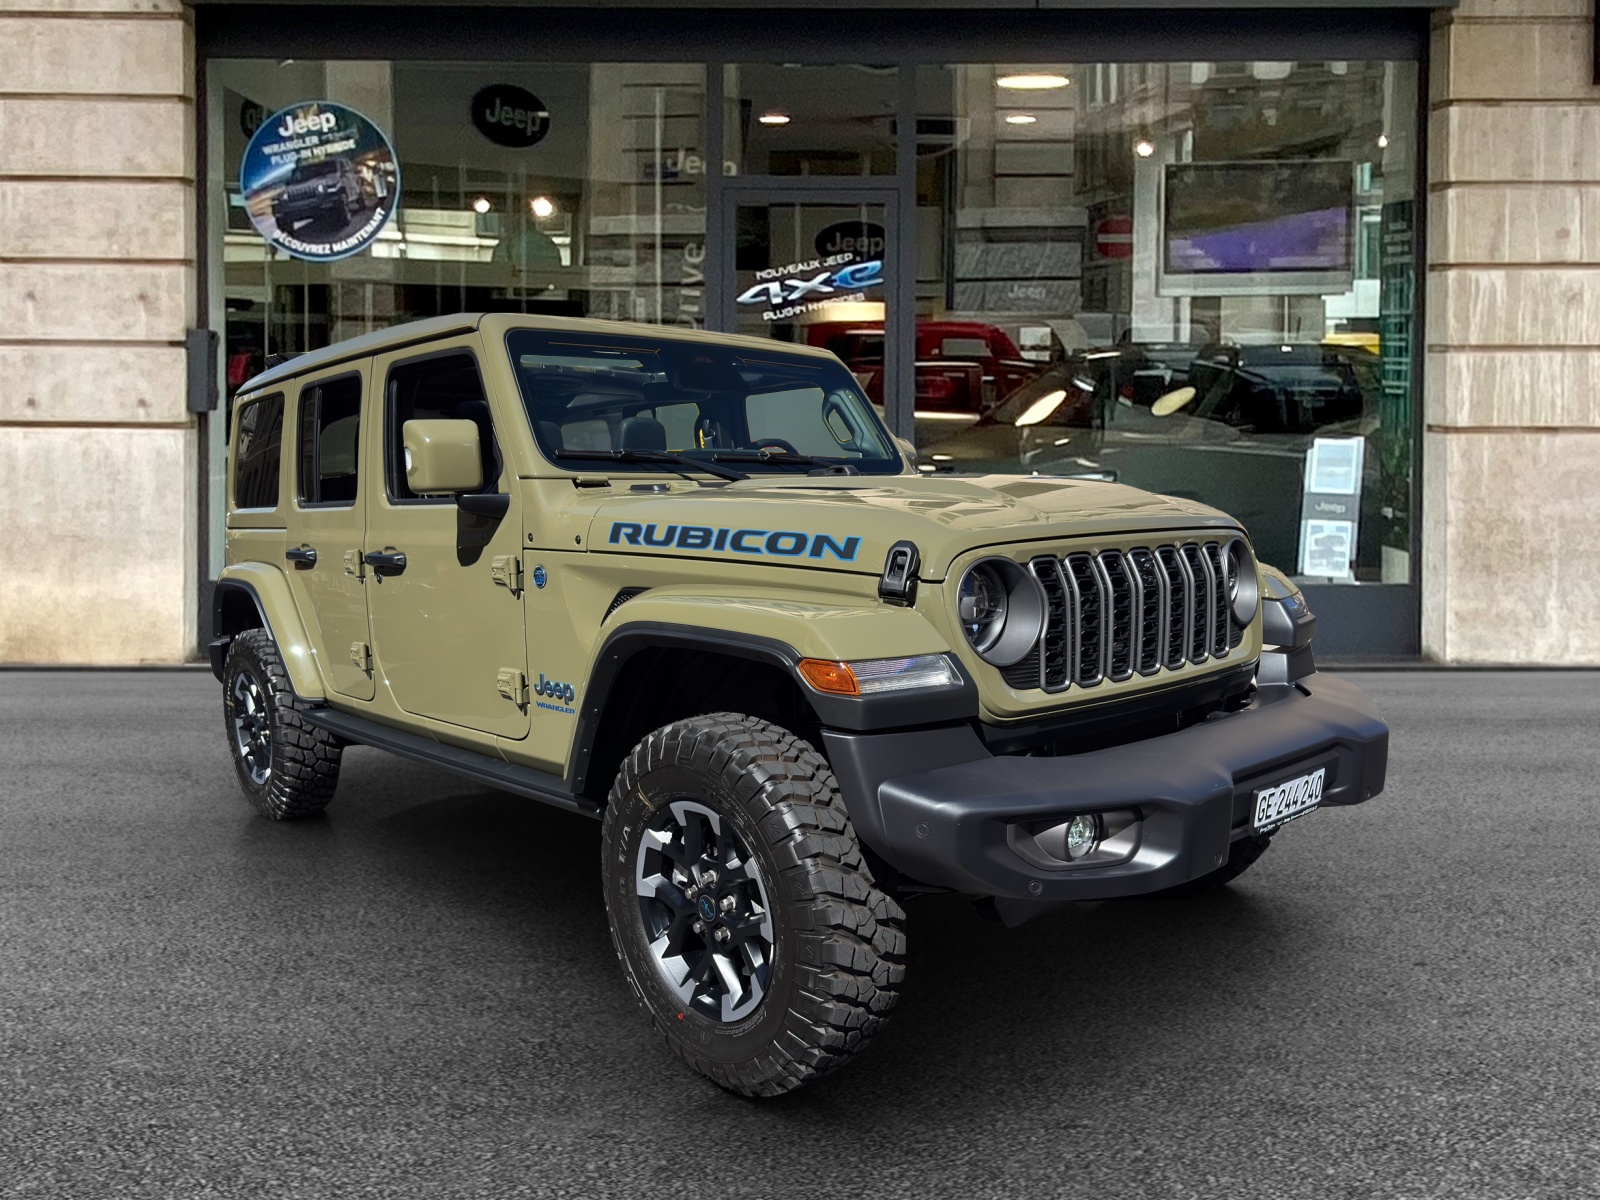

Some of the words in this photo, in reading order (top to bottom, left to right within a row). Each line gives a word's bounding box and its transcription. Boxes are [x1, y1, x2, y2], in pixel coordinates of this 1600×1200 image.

[278, 112, 337, 137] Jeep
[485, 97, 541, 136] Jeep
[262, 136, 319, 155] WRANGLER
[332, 207, 386, 252] MAINTENANT
[826, 232, 884, 256] Jeep
[756, 260, 821, 280] NOUVEAUX
[1314, 501, 1346, 514] Jeep
[608, 521, 863, 562] RUBICON
[534, 673, 575, 705] Jeep
[536, 700, 576, 715] WRANGLER
